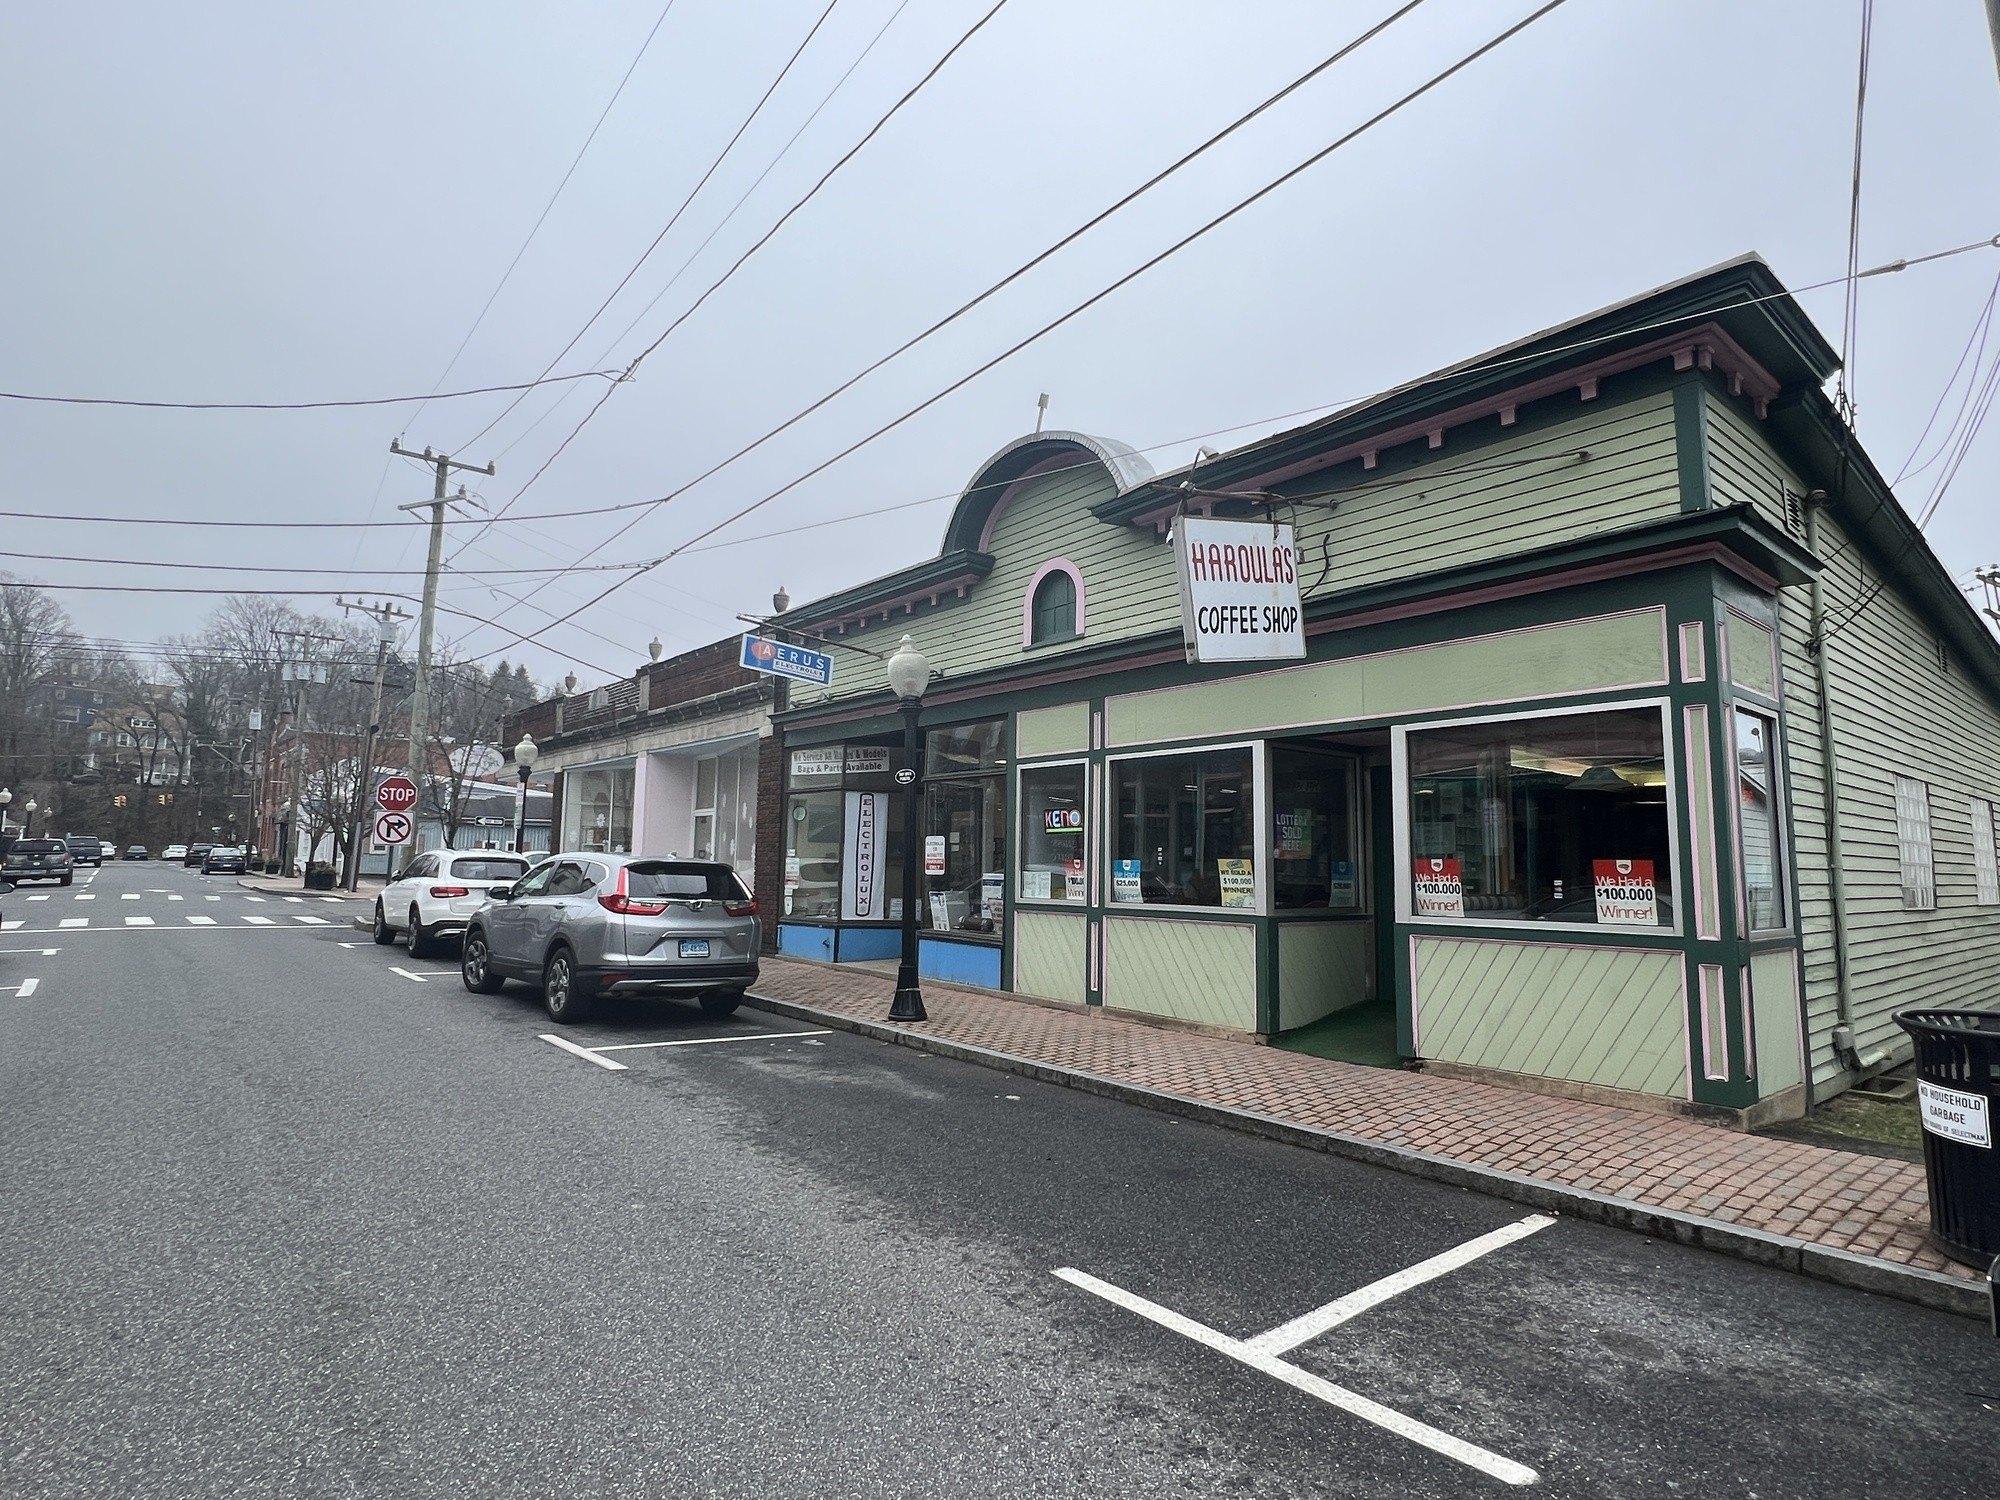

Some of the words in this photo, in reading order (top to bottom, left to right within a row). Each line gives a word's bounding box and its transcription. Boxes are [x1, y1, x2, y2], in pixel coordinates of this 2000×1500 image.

[1191, 542, 1294, 584] HAROULA'S
[1199, 605, 1259, 634] COFFEE
[1262, 605, 1298, 633] SHOP
[762, 644, 825, 670] AERUS
[775, 661, 824, 677] ELECTROLUX
[797, 764, 814, 773] Bags
[816, 764, 822, 772] &
[846, 762, 883, 772] Available
[379, 787, 415, 801] STOP
[1282, 826, 1302, 839] SOLD
[859, 798, 872, 905] ELECTROLUX
[1415, 873, 1430, 883] We
[1432, 873, 1451, 883] Had
[1452, 875, 1459, 883] a
[1595, 875, 1616, 886] We
[1618, 875, 1642, 887] Had
[1644, 878, 1653, 887] a
[1418, 898, 1460, 911] Winner!
[1599, 905, 1653, 920] Winner!
[1929, 1088, 1981, 1111] HOUSEHOLD
[1929, 1105, 1966, 1125] GARBAGE
